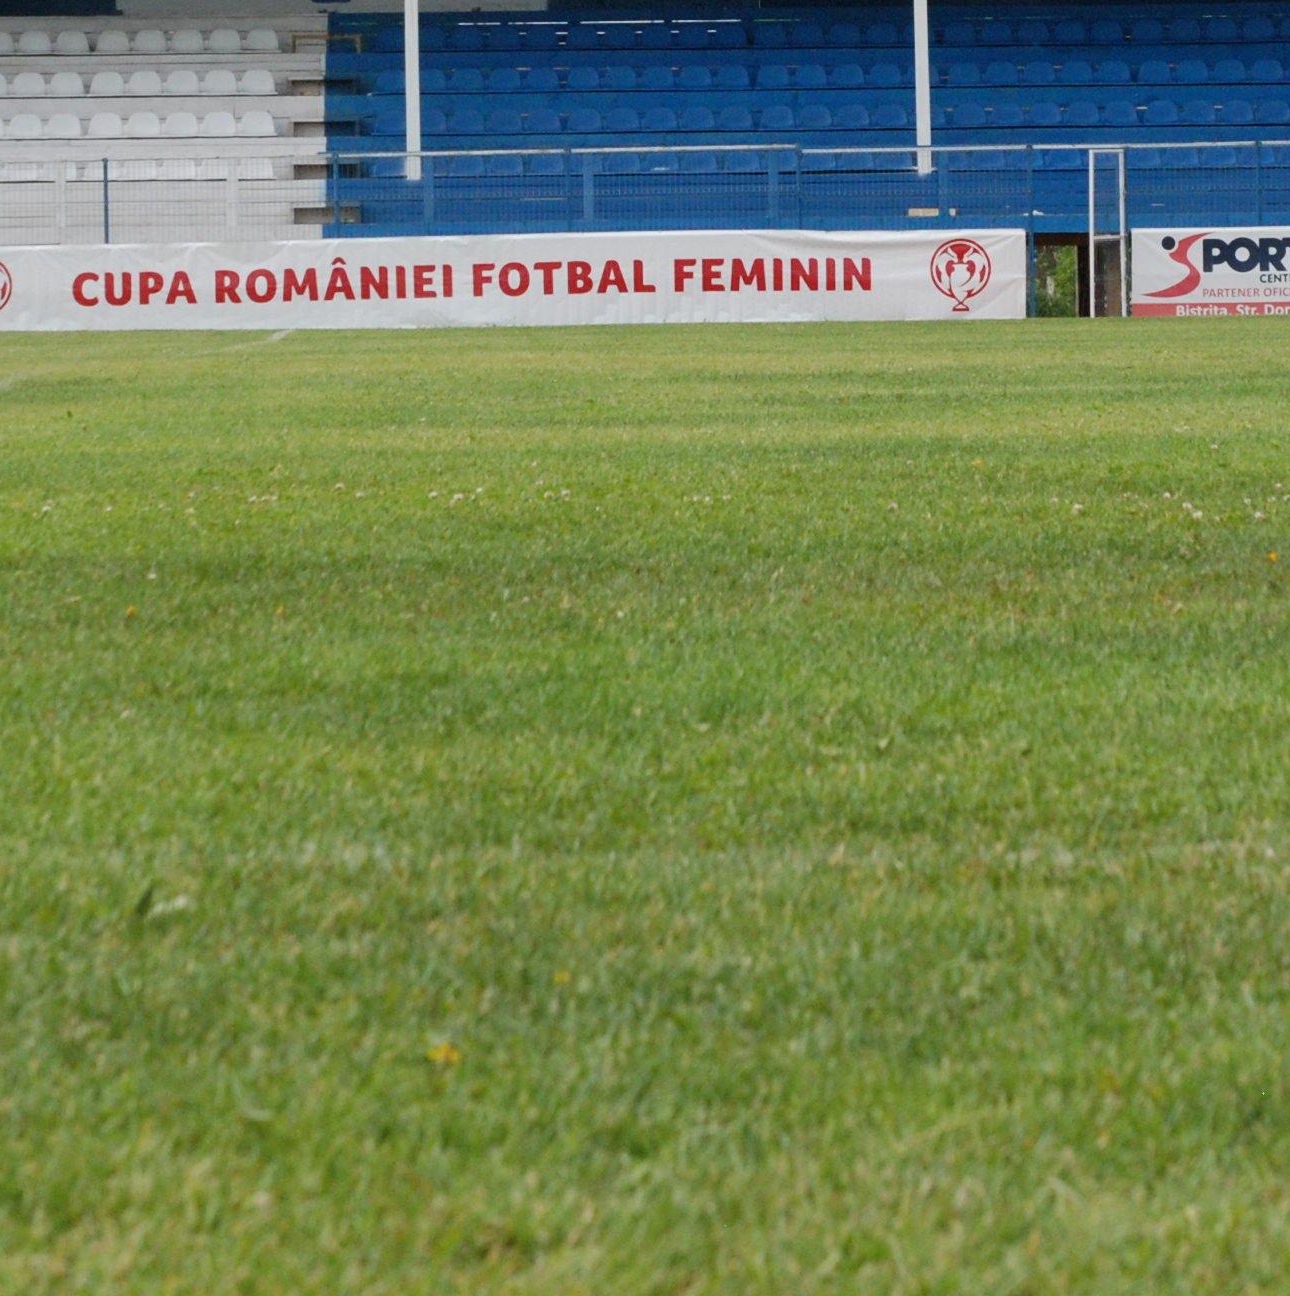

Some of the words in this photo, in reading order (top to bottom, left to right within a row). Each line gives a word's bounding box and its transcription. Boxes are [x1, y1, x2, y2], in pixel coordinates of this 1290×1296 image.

[72, 270, 197, 306] CUPA
[214, 257, 453, 304] ROMÂNIEI
[472, 260, 656, 296] FOTBAL
[674, 257, 872, 292] FEMININ
[1203, 287, 1260, 297] PARTENER
[1236, 304, 1260, 316] Str.
